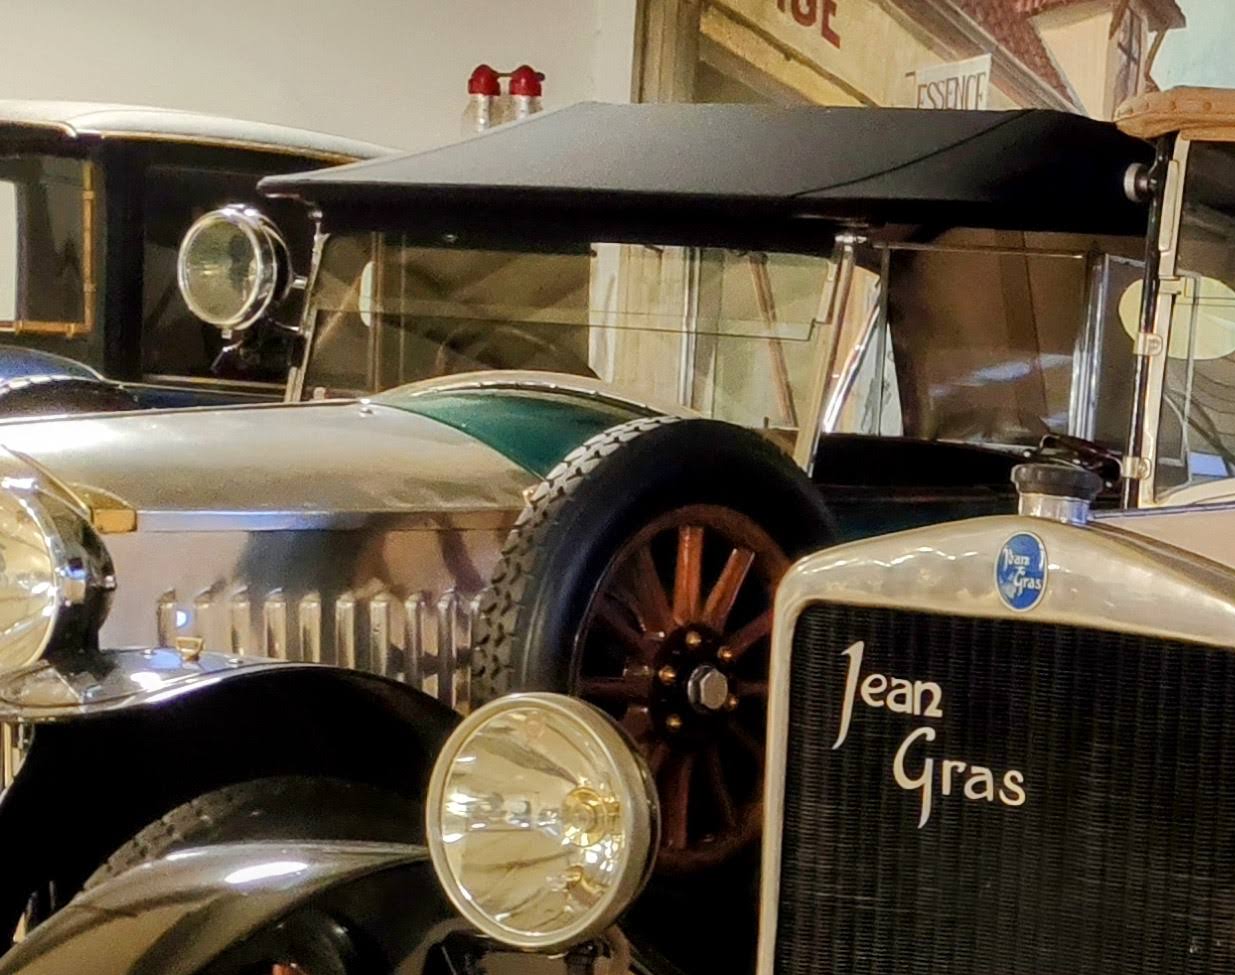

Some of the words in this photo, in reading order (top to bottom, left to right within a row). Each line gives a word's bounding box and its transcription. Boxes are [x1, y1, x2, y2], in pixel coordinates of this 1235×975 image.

[777, 0, 841, 49] GE
[832, 640, 944, 750] Jean
[893, 726, 1027, 830] Gras
